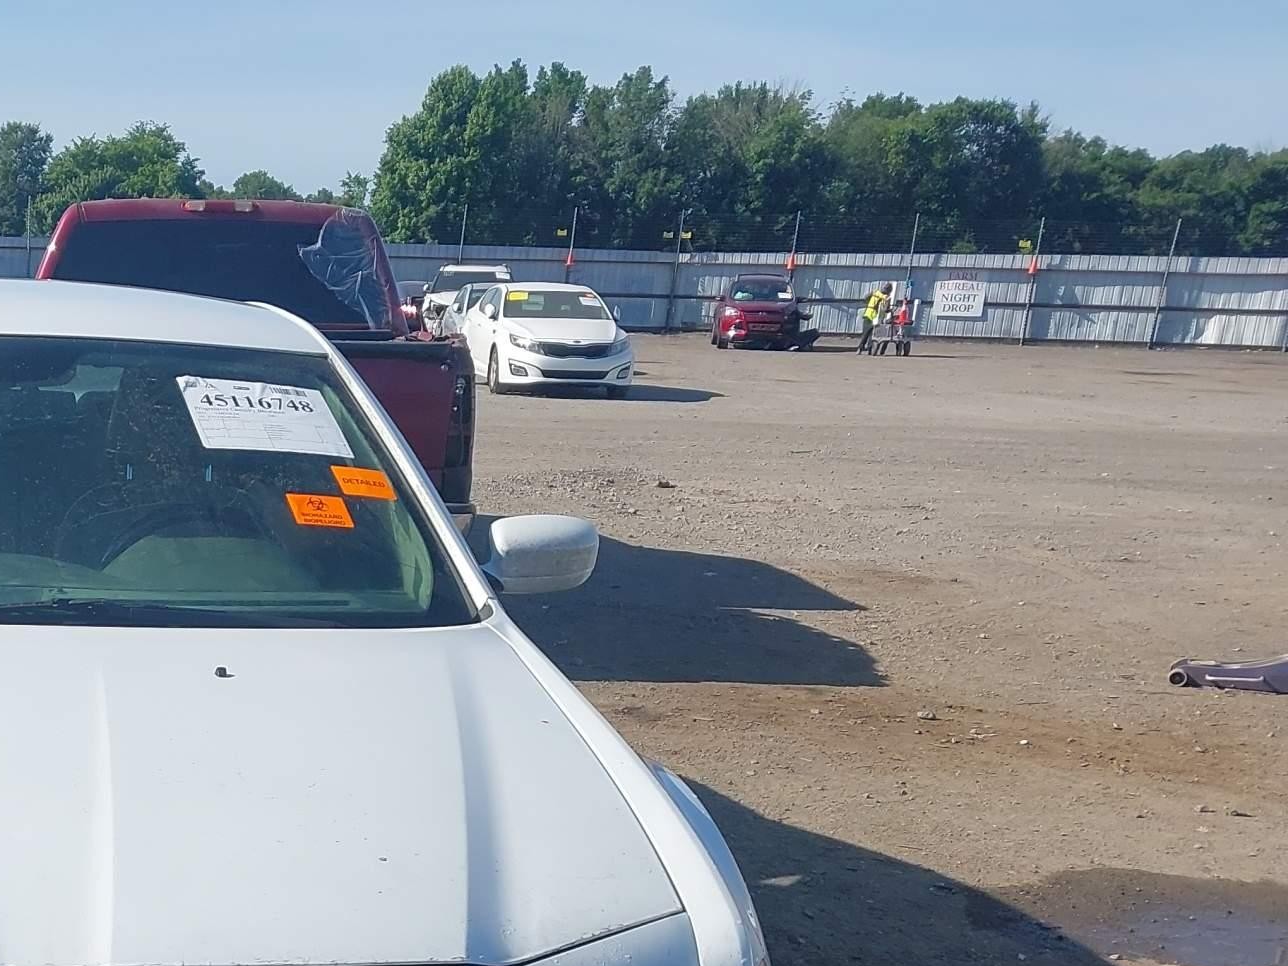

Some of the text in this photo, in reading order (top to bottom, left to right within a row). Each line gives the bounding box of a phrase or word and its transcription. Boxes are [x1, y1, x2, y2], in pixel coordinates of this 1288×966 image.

[939, 282, 984, 291] BUREAU
[941, 293, 978, 303] NIGHT
[942, 304, 974, 313] DROP
[200, 393, 314, 412] 45116748
[342, 477, 385, 488] DETAILED
